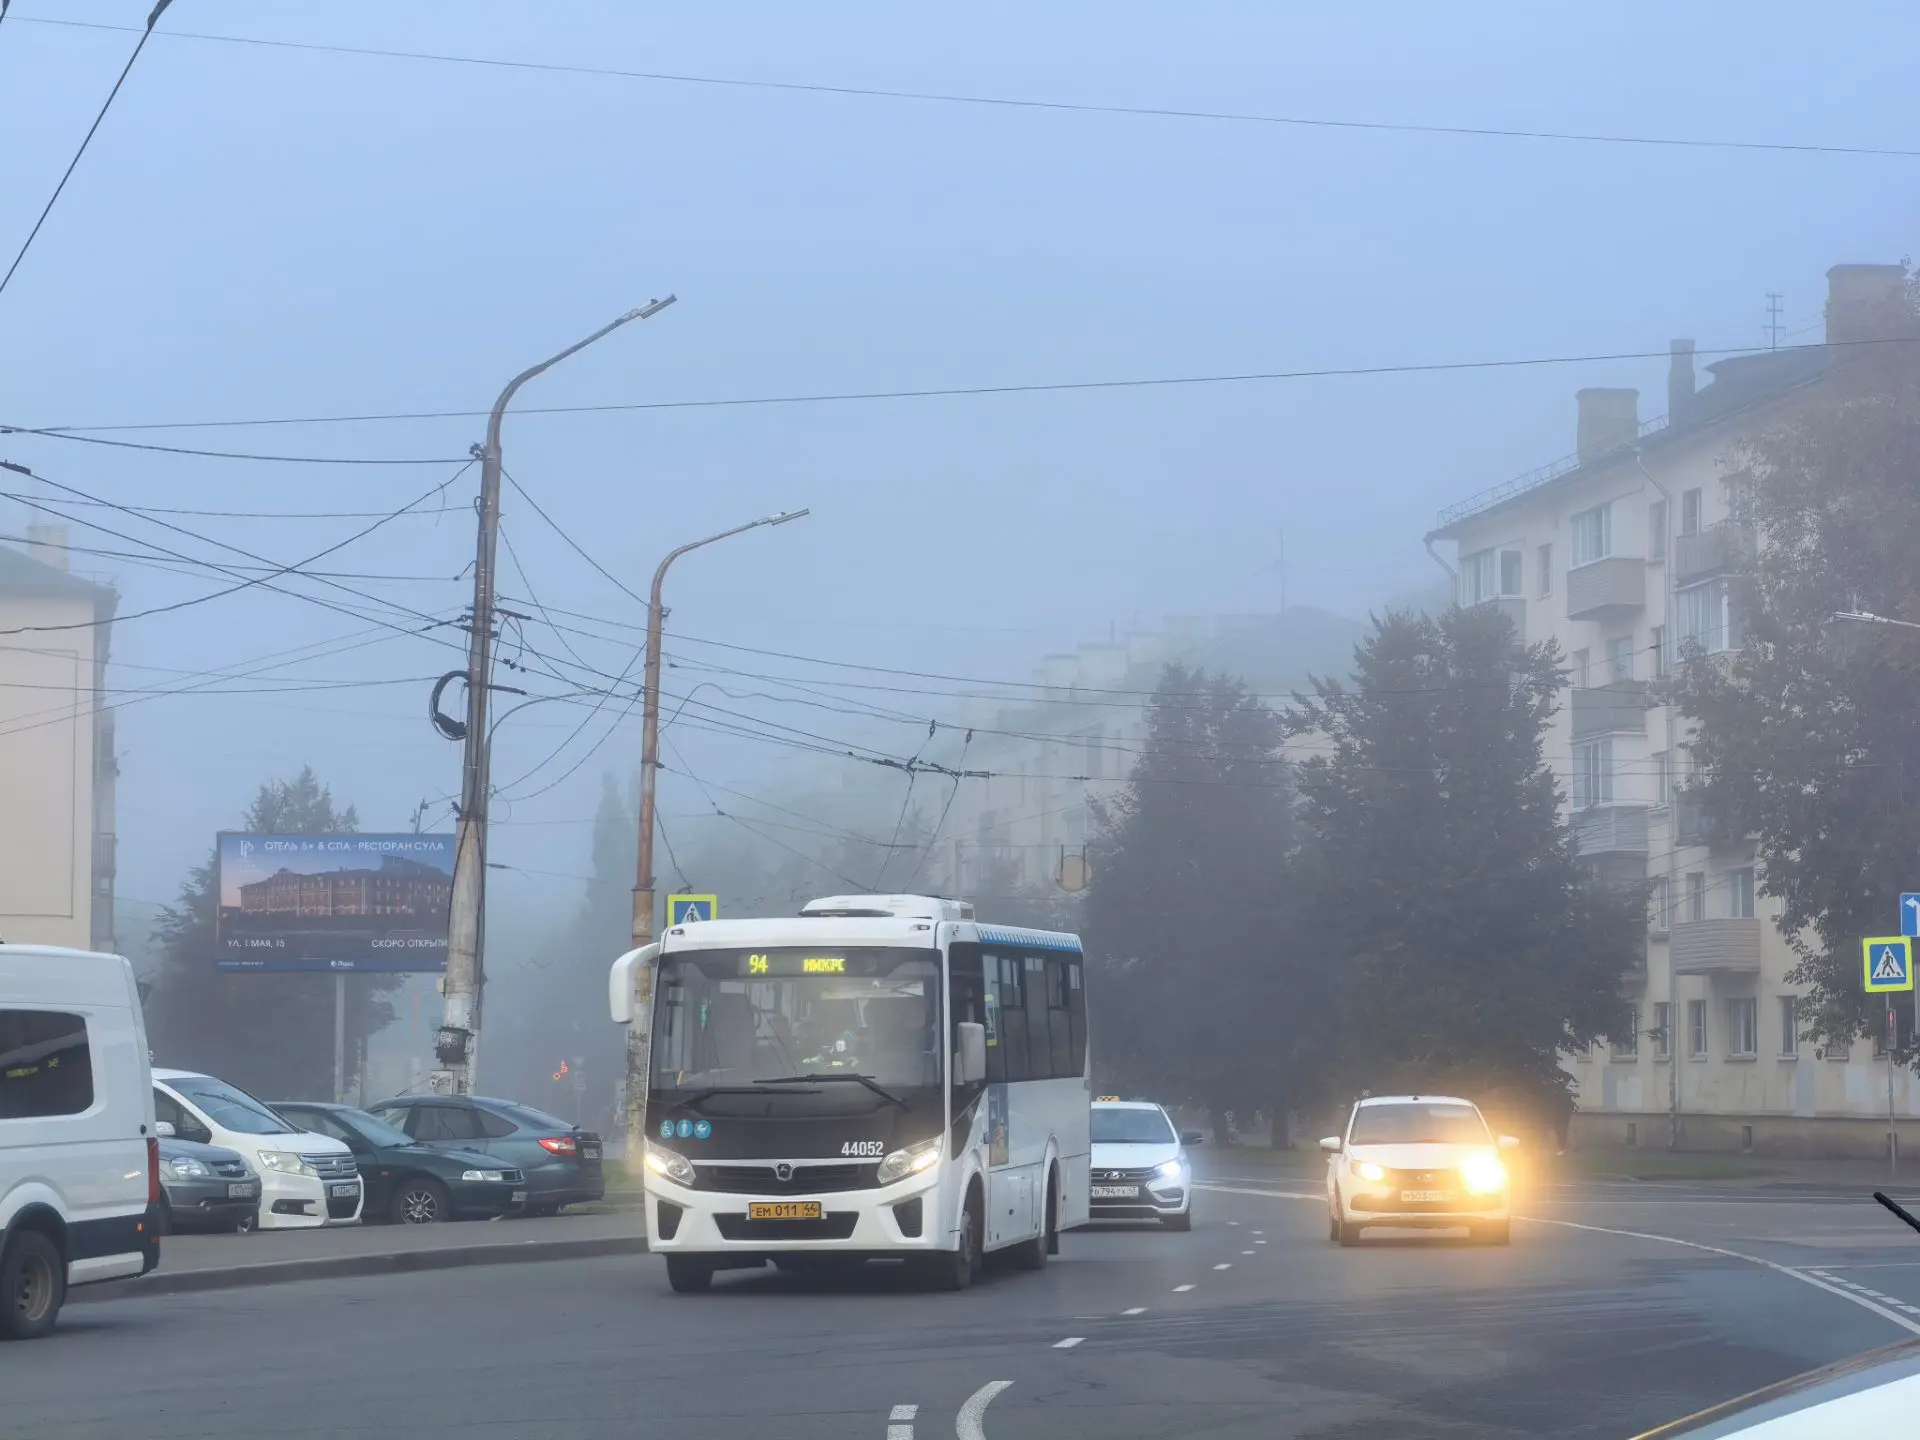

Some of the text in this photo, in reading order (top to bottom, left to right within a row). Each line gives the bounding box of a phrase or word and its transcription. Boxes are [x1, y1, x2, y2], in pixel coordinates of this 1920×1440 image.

[263, 841, 298, 851] ОТЕЛЬ
[327, 841, 351, 851] СПА
[358, 841, 412, 851] РЕСТОРАН
[414, 841, 444, 851] СУЛА
[371, 939, 448, 948] СКОРО ОТКРЫТИ
[749, 954, 768, 973] 94
[841, 1141, 884, 1156] 44052
[775, 1205, 797, 1217] 011
